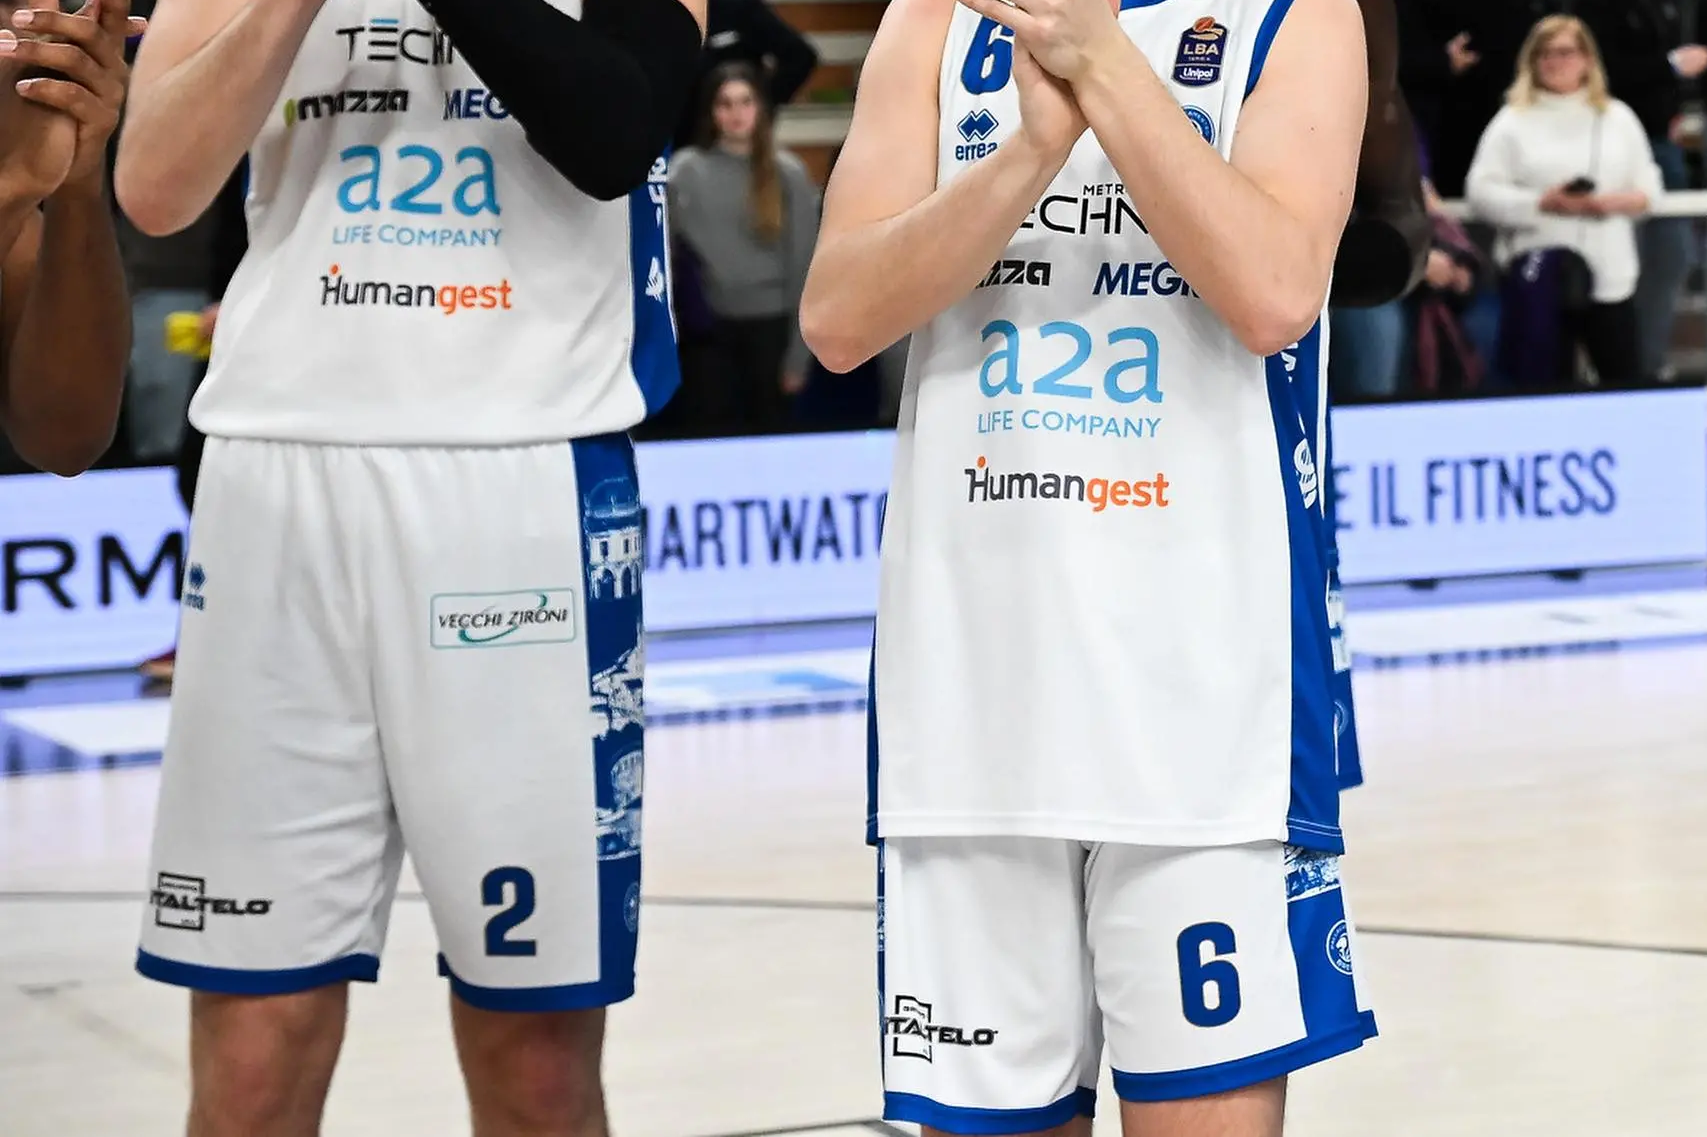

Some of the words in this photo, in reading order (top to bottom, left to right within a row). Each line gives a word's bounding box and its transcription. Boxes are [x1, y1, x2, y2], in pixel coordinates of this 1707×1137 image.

[960, 16, 1014, 95] 6
[1182, 68, 1214, 81] Unipol
[1183, 43, 1219, 55] LBA
[336, 143, 502, 218] a2a
[332, 224, 373, 245] LIFE
[377, 223, 503, 247] COMPANY
[319, 264, 513, 316] Humangest
[979, 318, 1164, 404] a2a
[977, 409, 1014, 434] LIFE
[1021, 409, 1162, 439] COMPANY
[964, 455, 1170, 512] Humangest
[1370, 464, 1409, 528] IL
[1425, 449, 1617, 526] FITNESS
[643, 492, 889, 571] ARTWAT
[438, 613, 502, 629] VECCHI
[507, 608, 568, 626] ZIRONI
[481, 866, 538, 957] 2
[1176, 921, 1242, 1028] 6
